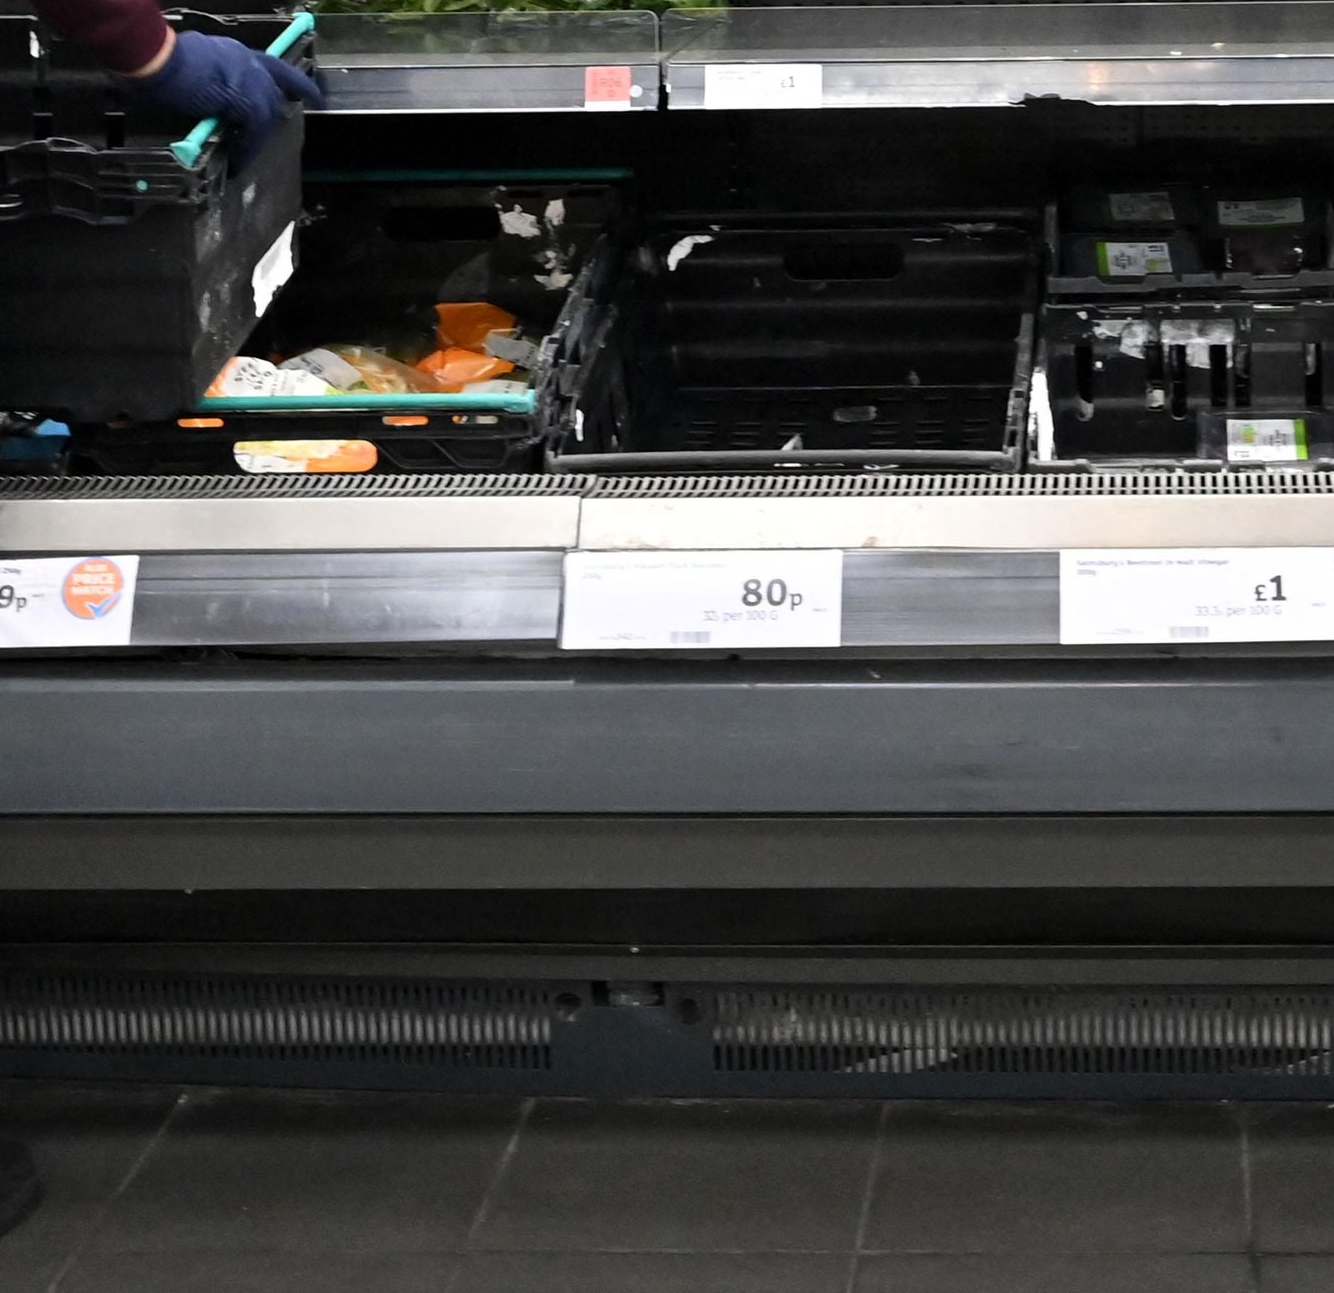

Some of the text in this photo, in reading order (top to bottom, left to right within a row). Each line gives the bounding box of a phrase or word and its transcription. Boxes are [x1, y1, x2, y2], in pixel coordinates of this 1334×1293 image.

[73, 573, 116, 585] PRICE
[1253, 573, 1288, 602] £1
[72, 585, 114, 595] MATCH
[741, 577, 804, 612] 80p
